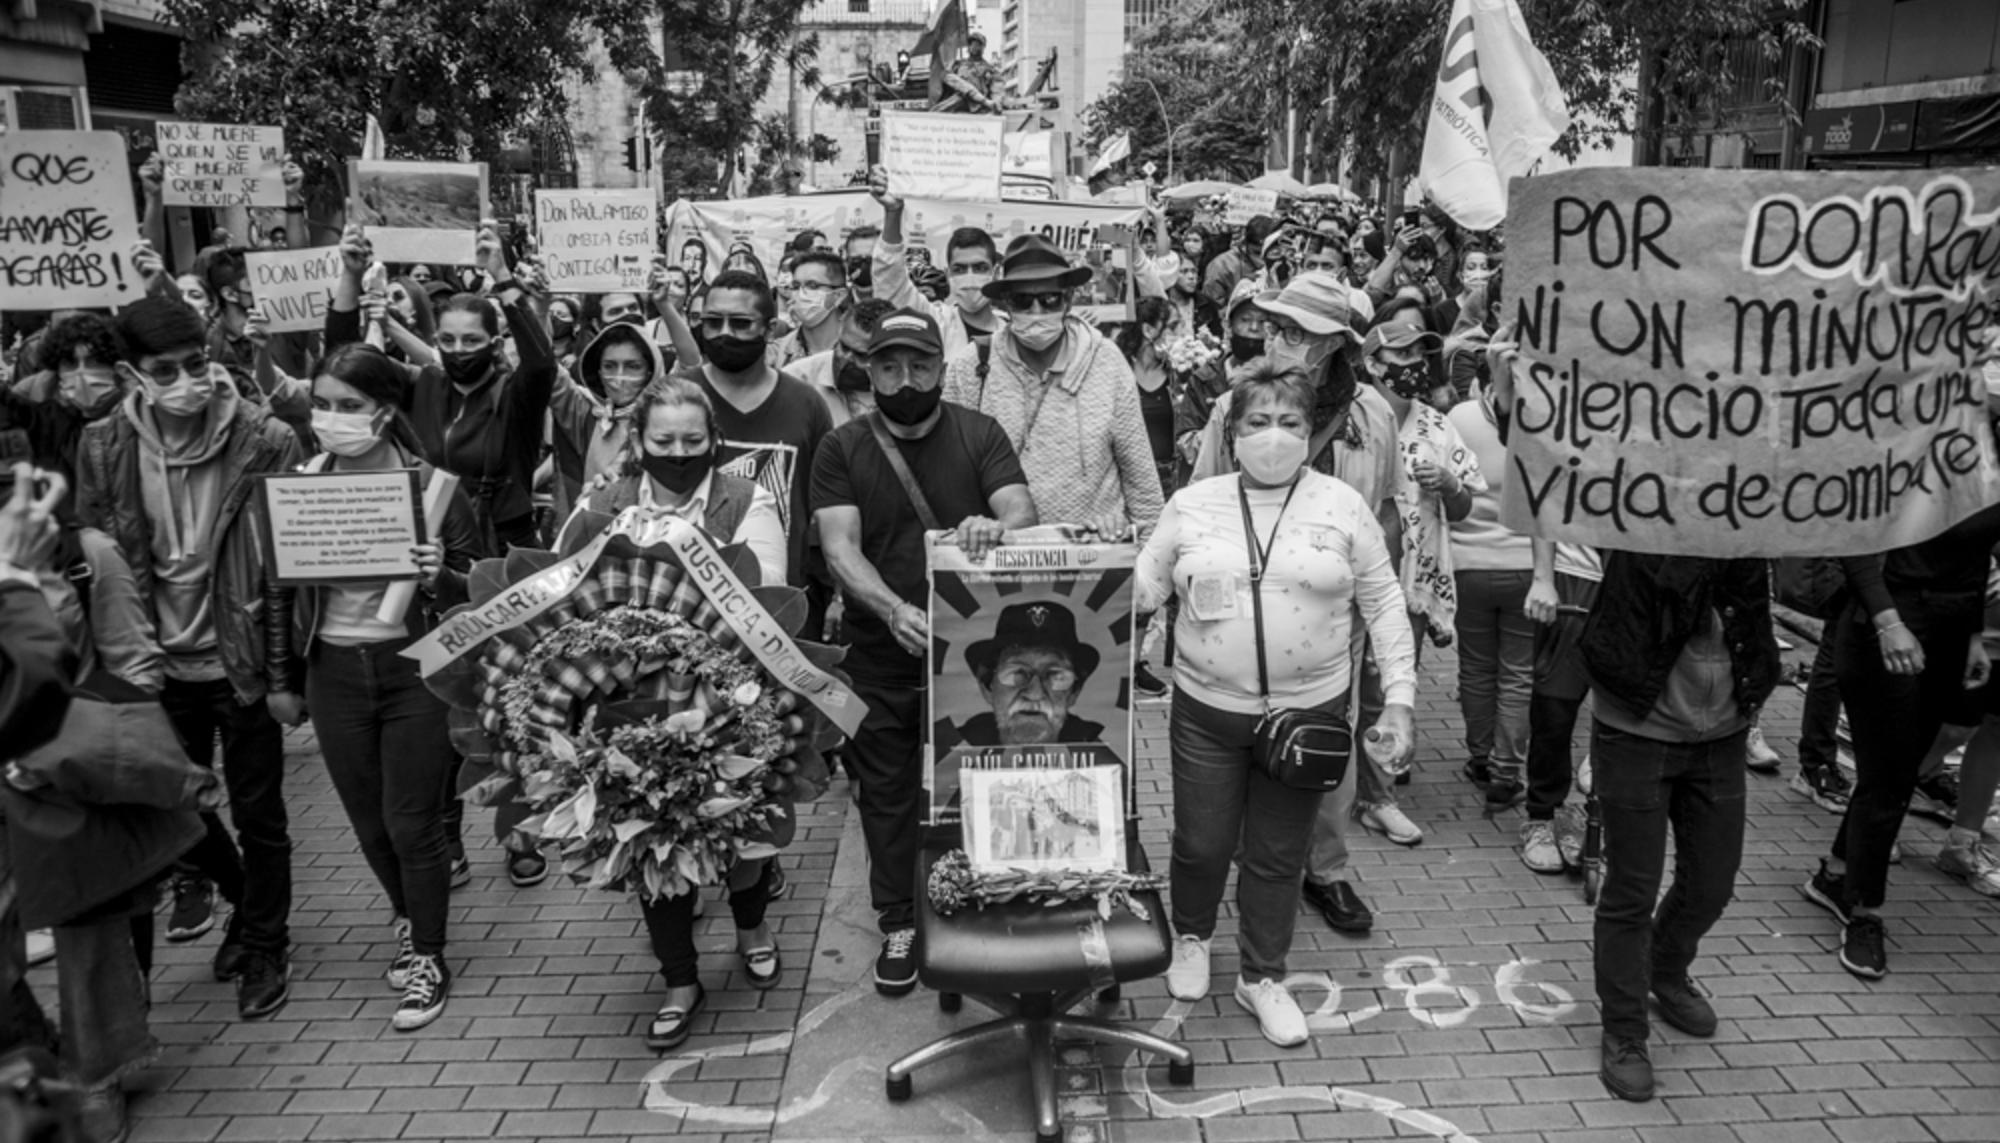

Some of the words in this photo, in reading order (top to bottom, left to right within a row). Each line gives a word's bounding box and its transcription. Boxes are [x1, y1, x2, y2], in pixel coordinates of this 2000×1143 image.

[159, 124, 181, 140] NO
[185, 124, 201, 140] SE
[213, 126, 261, 142] MUERE
[1434, 96, 1489, 157] PATRIÓTICA
[166, 143, 215, 159] QUIEN
[225, 144, 251, 161] SE
[12, 153, 94, 186] QUE
[167, 161, 186, 176] SE
[195, 160, 249, 176] MUERE
[172, 177, 223, 193] QUIEN
[241, 177, 260, 193] SE
[188, 191, 253, 206] OLVIDA
[542, 197, 567, 223] DON
[603, 203, 649, 221] AMIGO
[0, 207, 114, 247] AMASTE
[1554, 195, 1681, 271] POR
[1750, 194, 1911, 286] DON
[257, 263, 299, 285] DON
[1590, 298, 1686, 370] UN
[1516, 358, 1763, 450] Silencio
[1698, 463, 1779, 531] de
[995, 549, 1068, 569] RESISTENCIA
[681, 537, 761, 635] JUSTICIA
